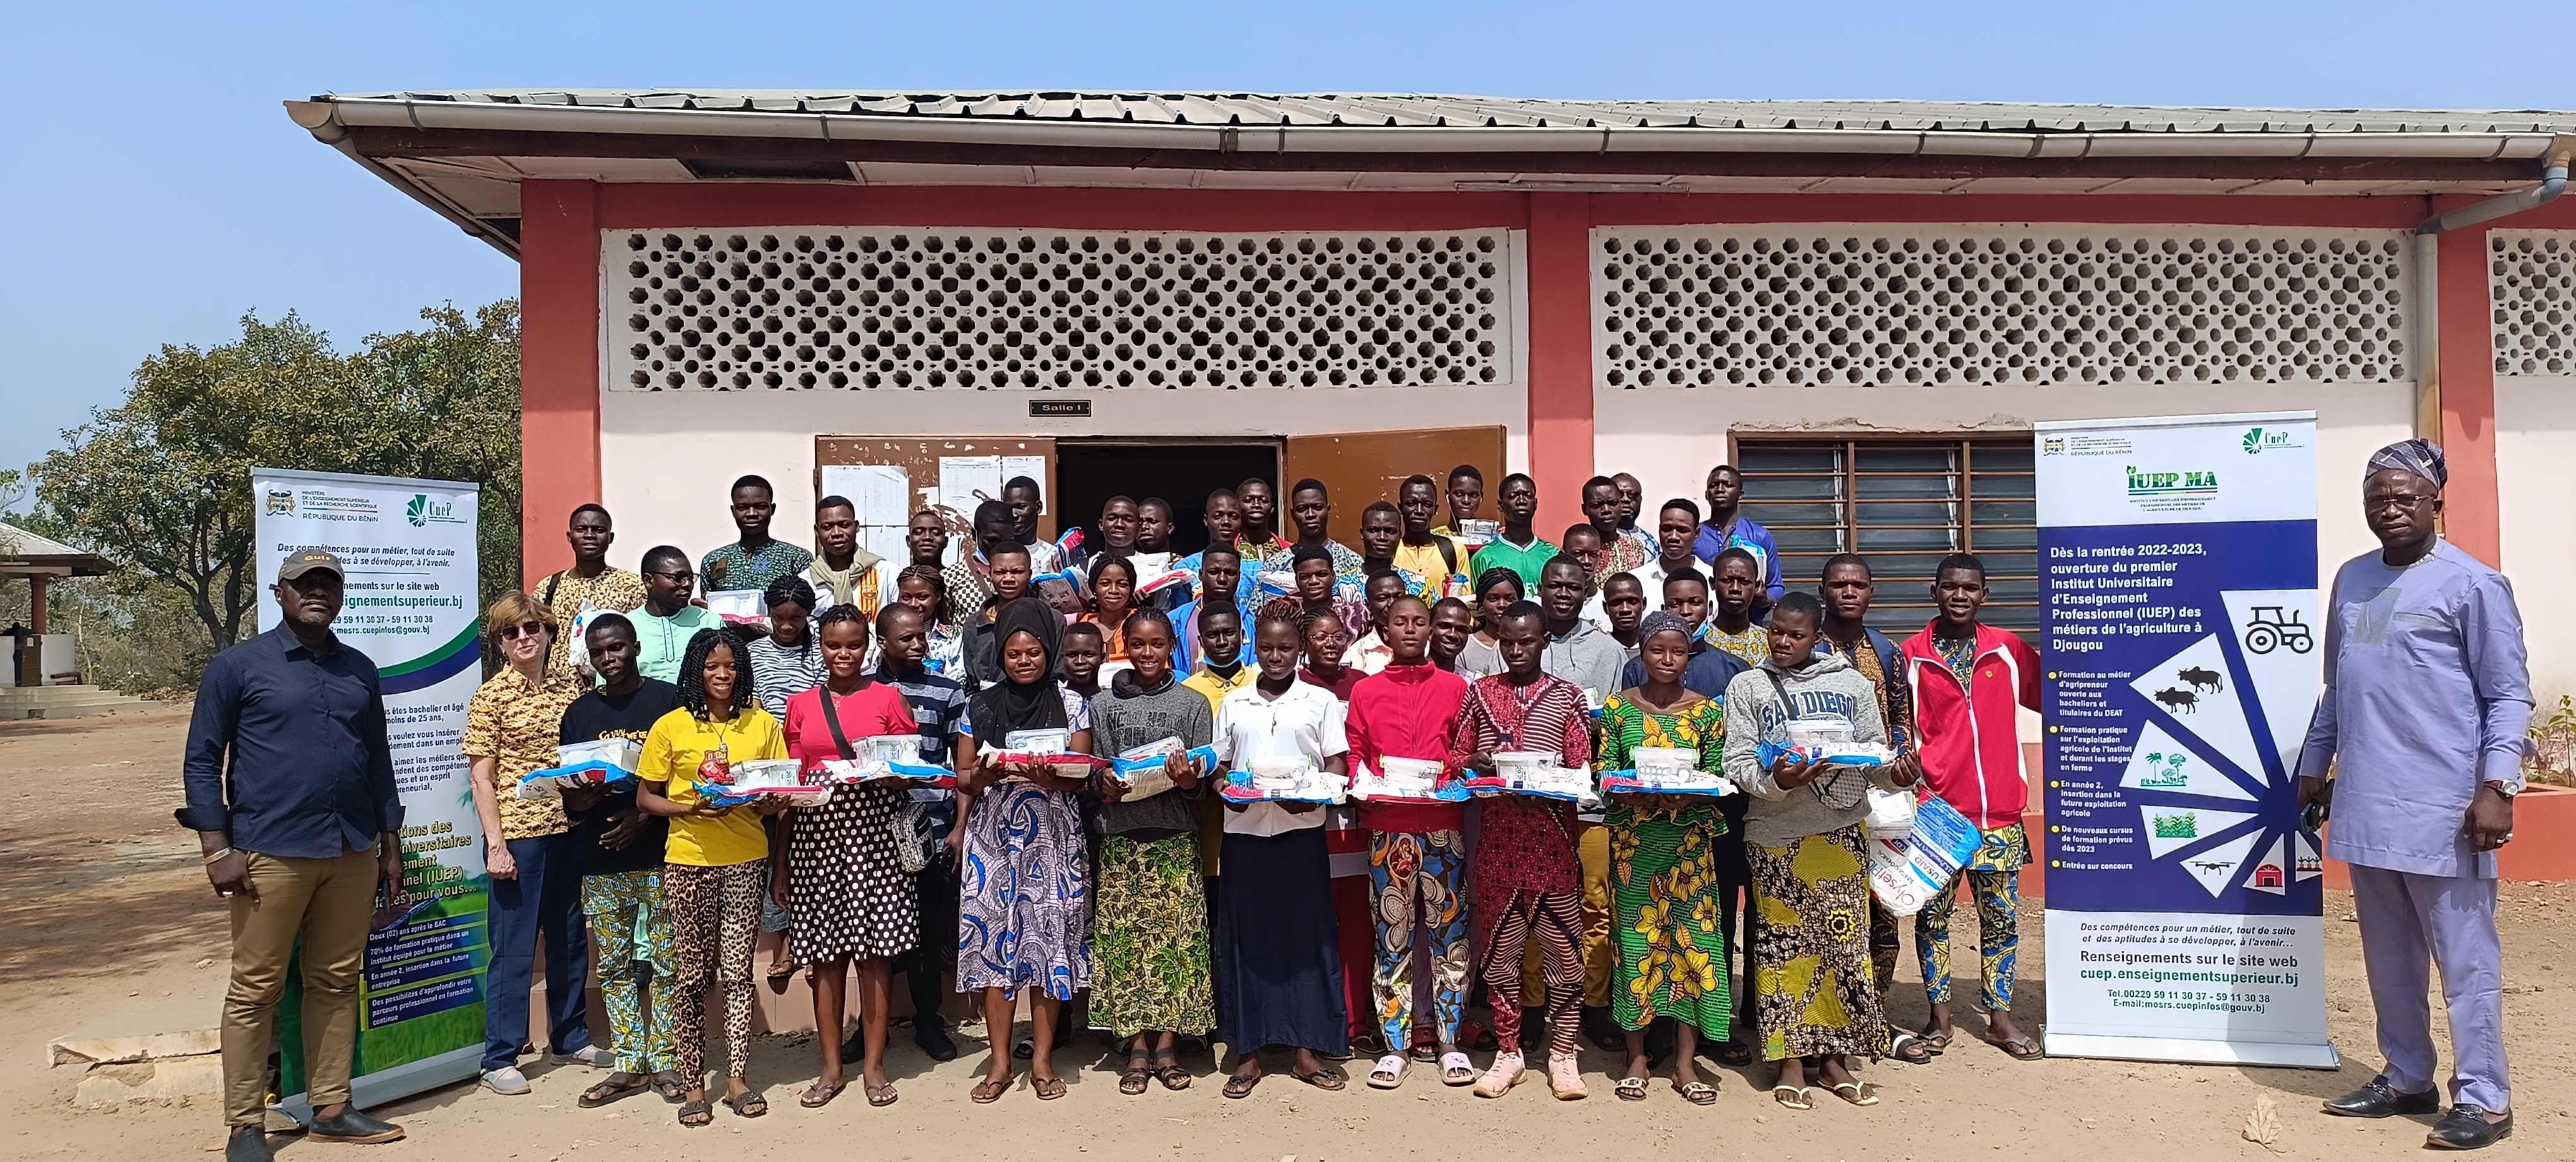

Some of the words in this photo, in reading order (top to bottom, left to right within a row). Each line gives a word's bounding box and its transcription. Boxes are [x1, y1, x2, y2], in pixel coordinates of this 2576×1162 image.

[2185, 471, 2217, 487] MA
[303, 513, 345, 521] RÉPUBLIQUE
[382, 546, 408, 555] métier,
[411, 547, 424, 555] tout
[2050, 546, 2073, 558] Dès
[2077, 546, 2087, 557] la
[2091, 545, 2134, 556] rentrée
[2137, 543, 2206, 556] 2022-2023,
[353, 556, 358, 564] à
[371, 557, 414, 567] développer,
[422, 558, 450, 566] l'avenir.
[2051, 563, 2108, 573] ouverture
[2112, 561, 2126, 572] du
[2130, 560, 2178, 574] premier
[397, 581, 404, 590] le
[407, 582, 421, 590] site
[423, 582, 439, 590] web
[2051, 578, 2094, 589] Institut
[2097, 576, 2173, 588] Universitaire
[2051, 592, 2147, 606] d’Enseignement
[2052, 607, 2133, 619] Professionnel
[2137, 606, 2174, 620] (IUEP)
[2179, 606, 2201, 617] des
[2053, 623, 2097, 634] métiers
[2101, 623, 2116, 634] de
[2120, 622, 2190, 635] l’agriculture
[2194, 621, 2202, 632] à
[2053, 638, 2102, 652] Djougou
[2059, 680, 2108, 689] d'agripreneur
[1801, 690, 1854, 722] DIEGO
[2060, 725, 2096, 733] Formation
[2098, 726, 2127, 735] pratique
[2096, 781, 2103, 789] 2,
[2061, 789, 2093, 798] insertion
[2061, 798, 2082, 806] future
[2084, 800, 2126, 808] exploitation
[2061, 808, 2090, 817] agricole
[432, 821, 452, 834] des
[2072, 835, 2107, 843] formation
[2109, 836, 2133, 844] prévus
[1877, 849, 1895, 866] CHEMICAL
[1914, 857, 1939, 880] USAID
[2062, 861, 2085, 869] Entrée
[427, 866, 463, 885] (IUEP)
[386, 929, 398, 938] (02)
[410, 924, 426, 933] après
[434, 919, 446, 928] BAC
[2100, 923, 2159, 932] compétences
[2200, 925, 2233, 935] métier,
[2272, 926, 2295, 935] suite
[370, 947, 383, 955] 70%
[393, 940, 420, 950] formation
[421, 935, 444, 946] pratique
[2114, 935, 2157, 944] aptitudes
[2159, 935, 2165, 943] à
[2181, 935, 2236, 946] développer,
[2239, 937, 2245, 945] à
[2248, 938, 2293, 947] l'avenir...
[371, 955, 391, 965] institut
[393, 950, 412, 961] équipé
[414, 948, 426, 957] pour
[434, 942, 452, 951] métier
[2080, 950, 2191, 965] Renseignements
[2196, 955, 2218, 964] sur
[2222, 954, 2234, 965] le
[2239, 954, 2264, 966] site
[2269, 955, 2298, 967] web
[379, 969, 397, 978] année
[405, 962, 429, 972] insertion
[371, 978, 400, 989] entreprise
[2080, 968, 2298, 987] cuep.enseignementsuperieur.bj
[385, 990, 418, 1005] possibilités
[419, 981, 456, 995] d'approfondir
[373, 1005, 398, 1017] parcours
[399, 994, 437, 1011] professionnel
[446, 987, 473, 998] formation
[2113, 998, 2264, 1014] E-mail:mesrs.cuepinfos@gouv.bj
[373, 1015, 398, 1026] continue
